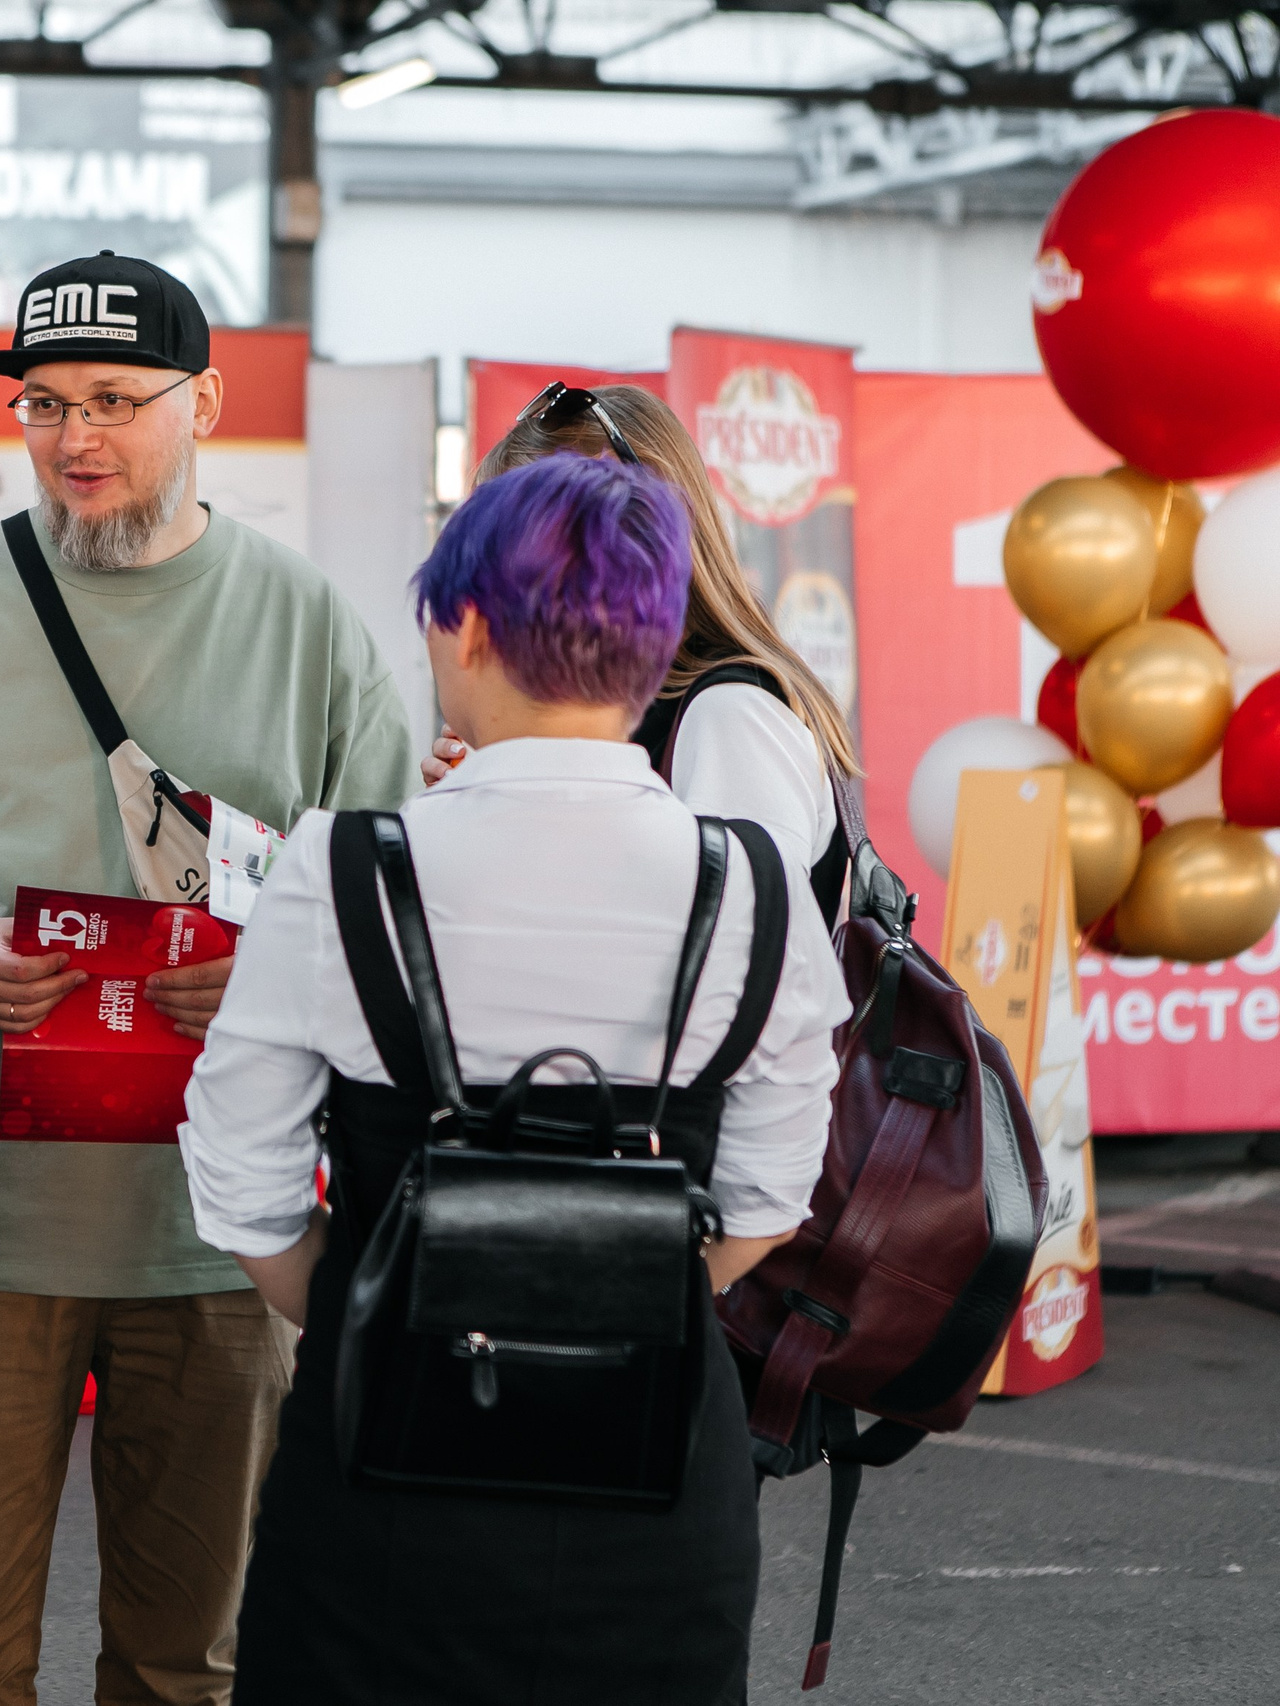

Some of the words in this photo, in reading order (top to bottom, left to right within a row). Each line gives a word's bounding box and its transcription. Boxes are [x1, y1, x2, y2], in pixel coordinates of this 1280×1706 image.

[23, 283, 138, 331] EMC
[52, 329, 79, 337] MUSIC
[81, 328, 134, 339] COALITION
[37, 908, 88, 950] 15
[86, 912, 101, 951] SELGROS
[99, 919, 109, 945] вместе
[98, 979, 120, 1021] SELGROS
